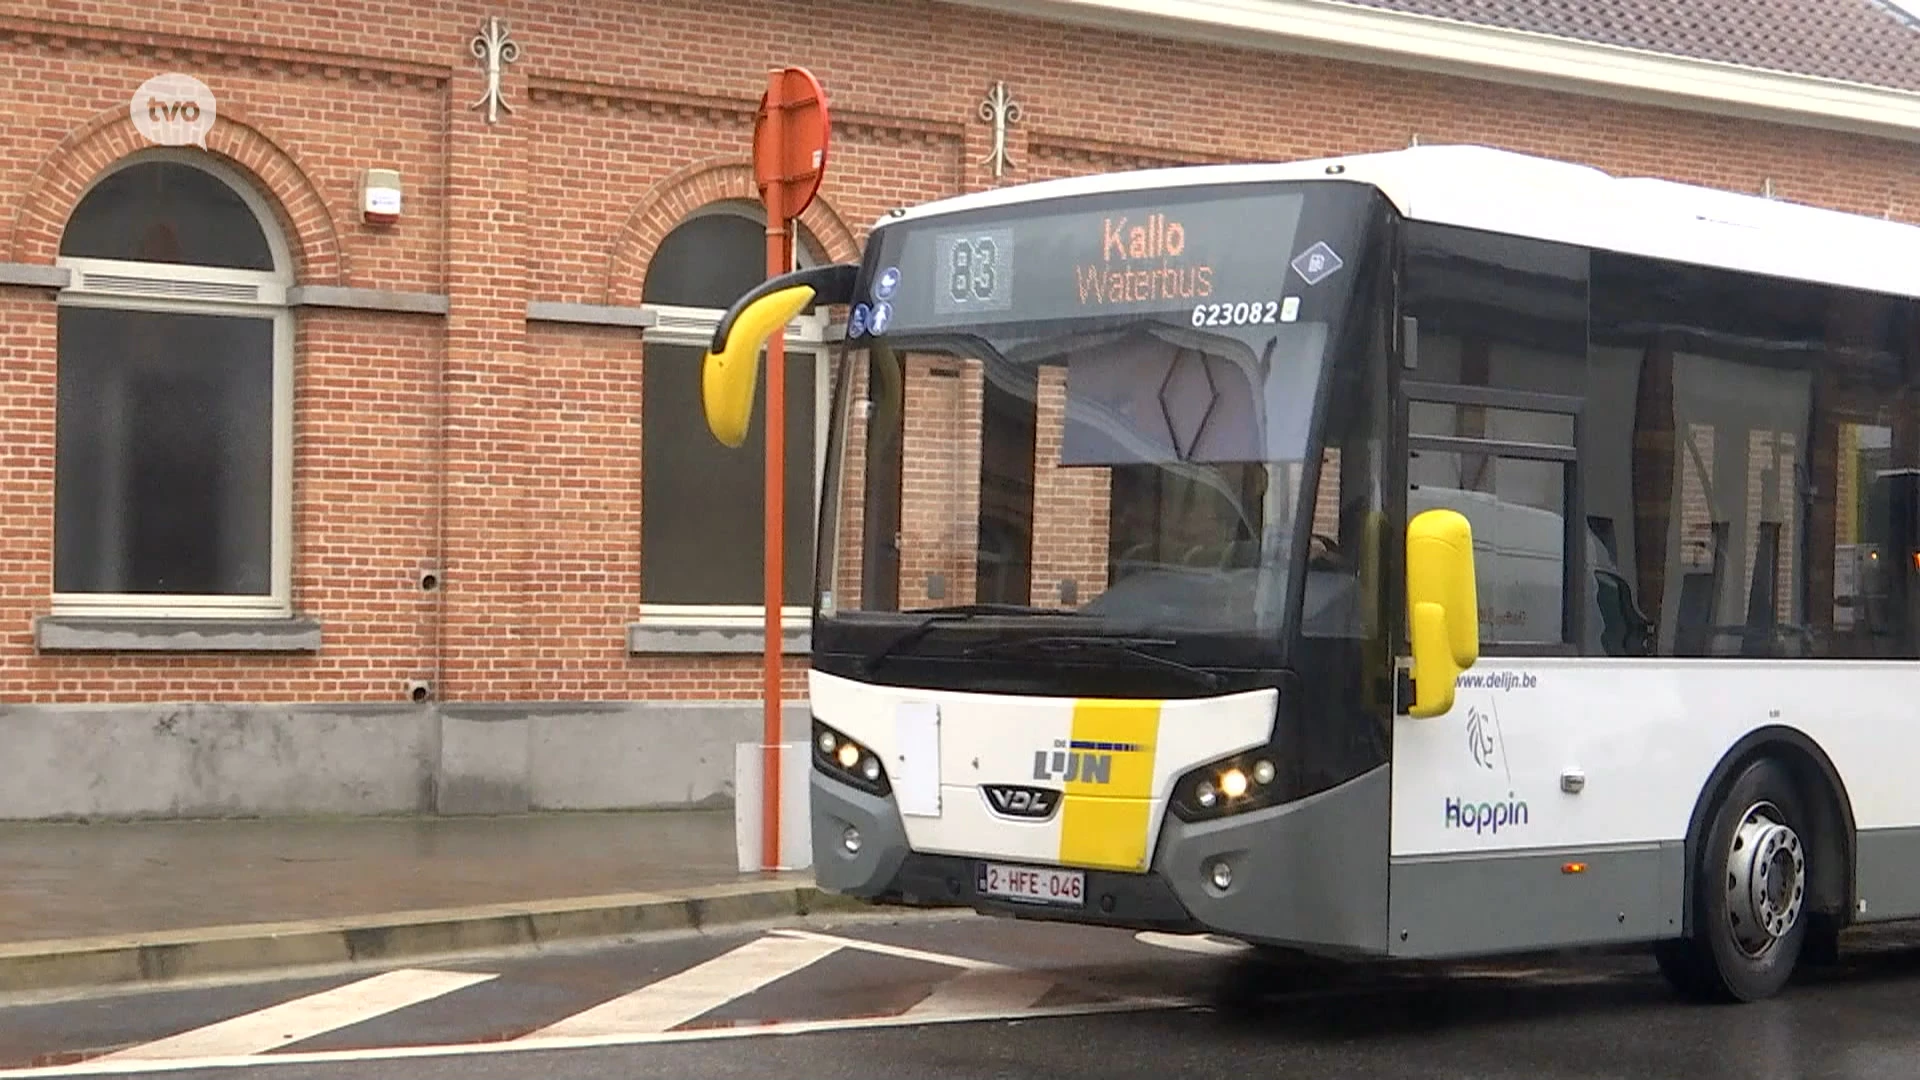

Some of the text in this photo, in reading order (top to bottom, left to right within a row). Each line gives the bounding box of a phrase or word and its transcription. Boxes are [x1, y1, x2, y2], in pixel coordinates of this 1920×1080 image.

[1103, 214, 1185, 261] Kallo
[949, 236, 999, 302] 83
[1076, 260, 1213, 304] Waterbus
[1191, 301, 1278, 326] 623082
[1033, 751, 1112, 784] LIJN
[991, 789, 1049, 811] VDL
[1445, 791, 1528, 835] Hoppin
[989, 868, 1081, 898] 2-HFE-046
